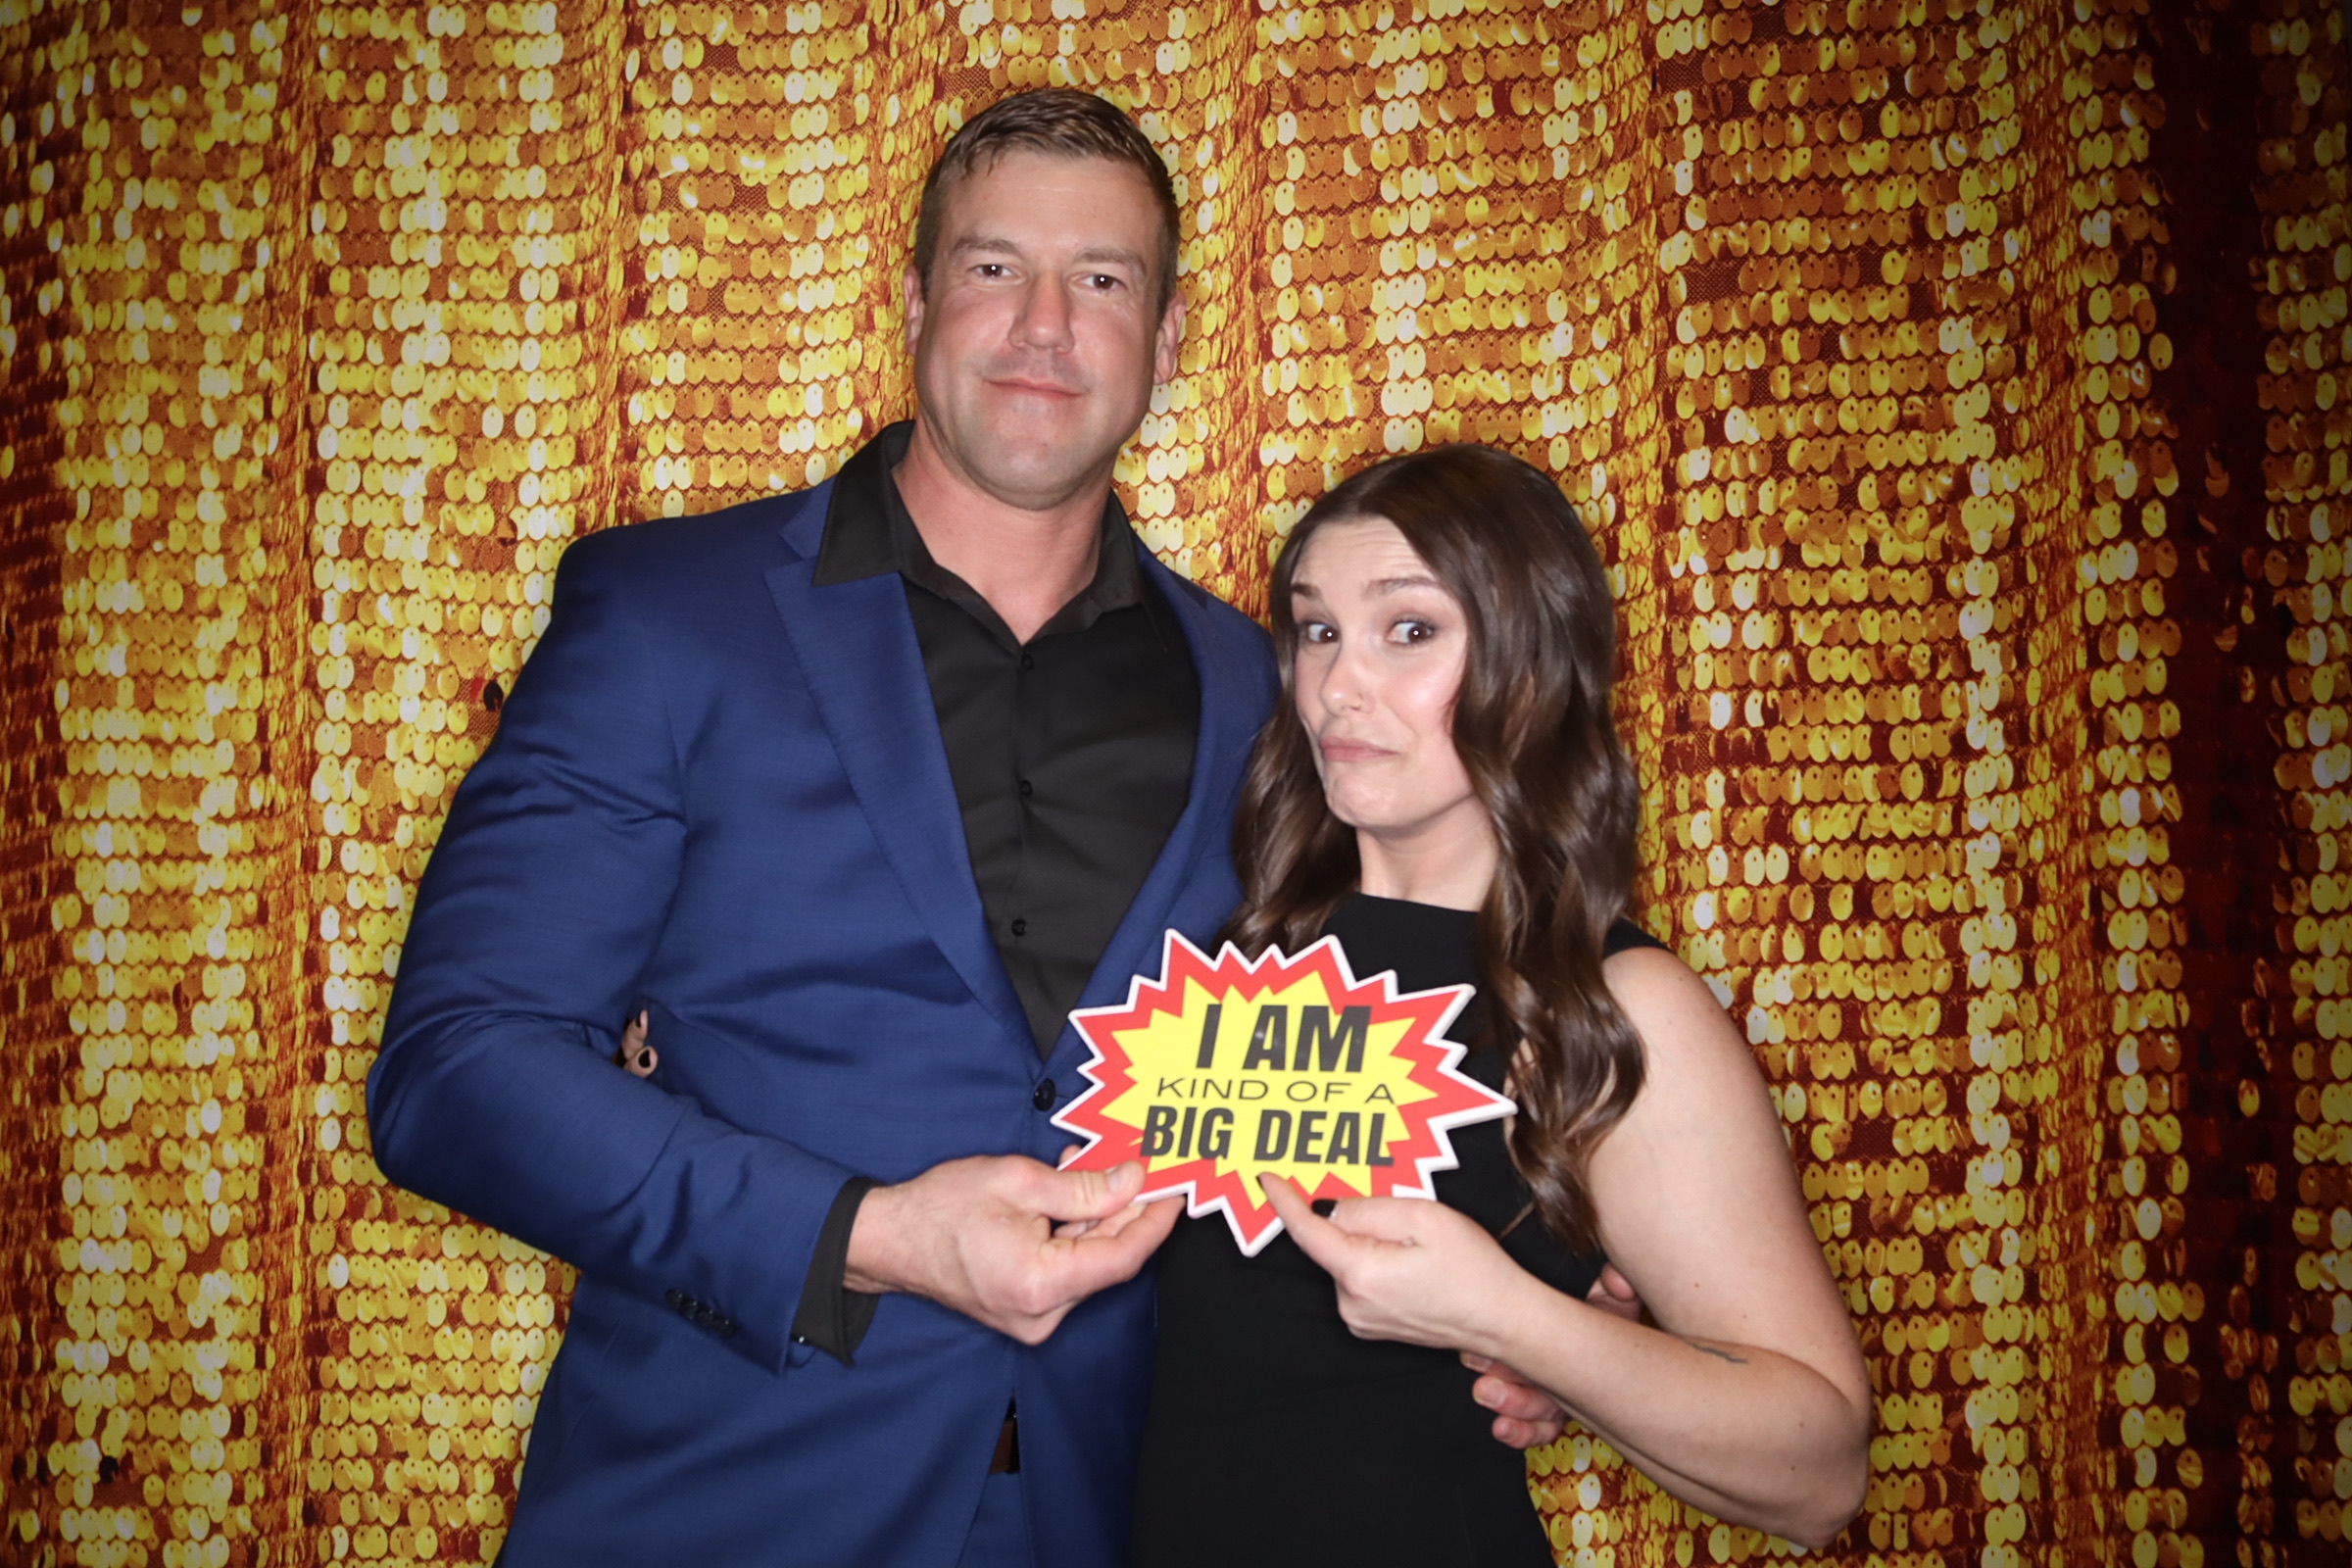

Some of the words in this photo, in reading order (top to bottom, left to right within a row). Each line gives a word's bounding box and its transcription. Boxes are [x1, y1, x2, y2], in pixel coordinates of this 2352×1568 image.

[1196, 1004, 1222, 1069] I
[1242, 1004, 1371, 1072] AM
[1156, 1076, 1269, 1101] KIND
[1286, 1080, 1352, 1103] OF
[1364, 1083, 1396, 1105] A
[1140, 1105, 1234, 1159] BIG
[1253, 1109, 1394, 1166] DEAL
